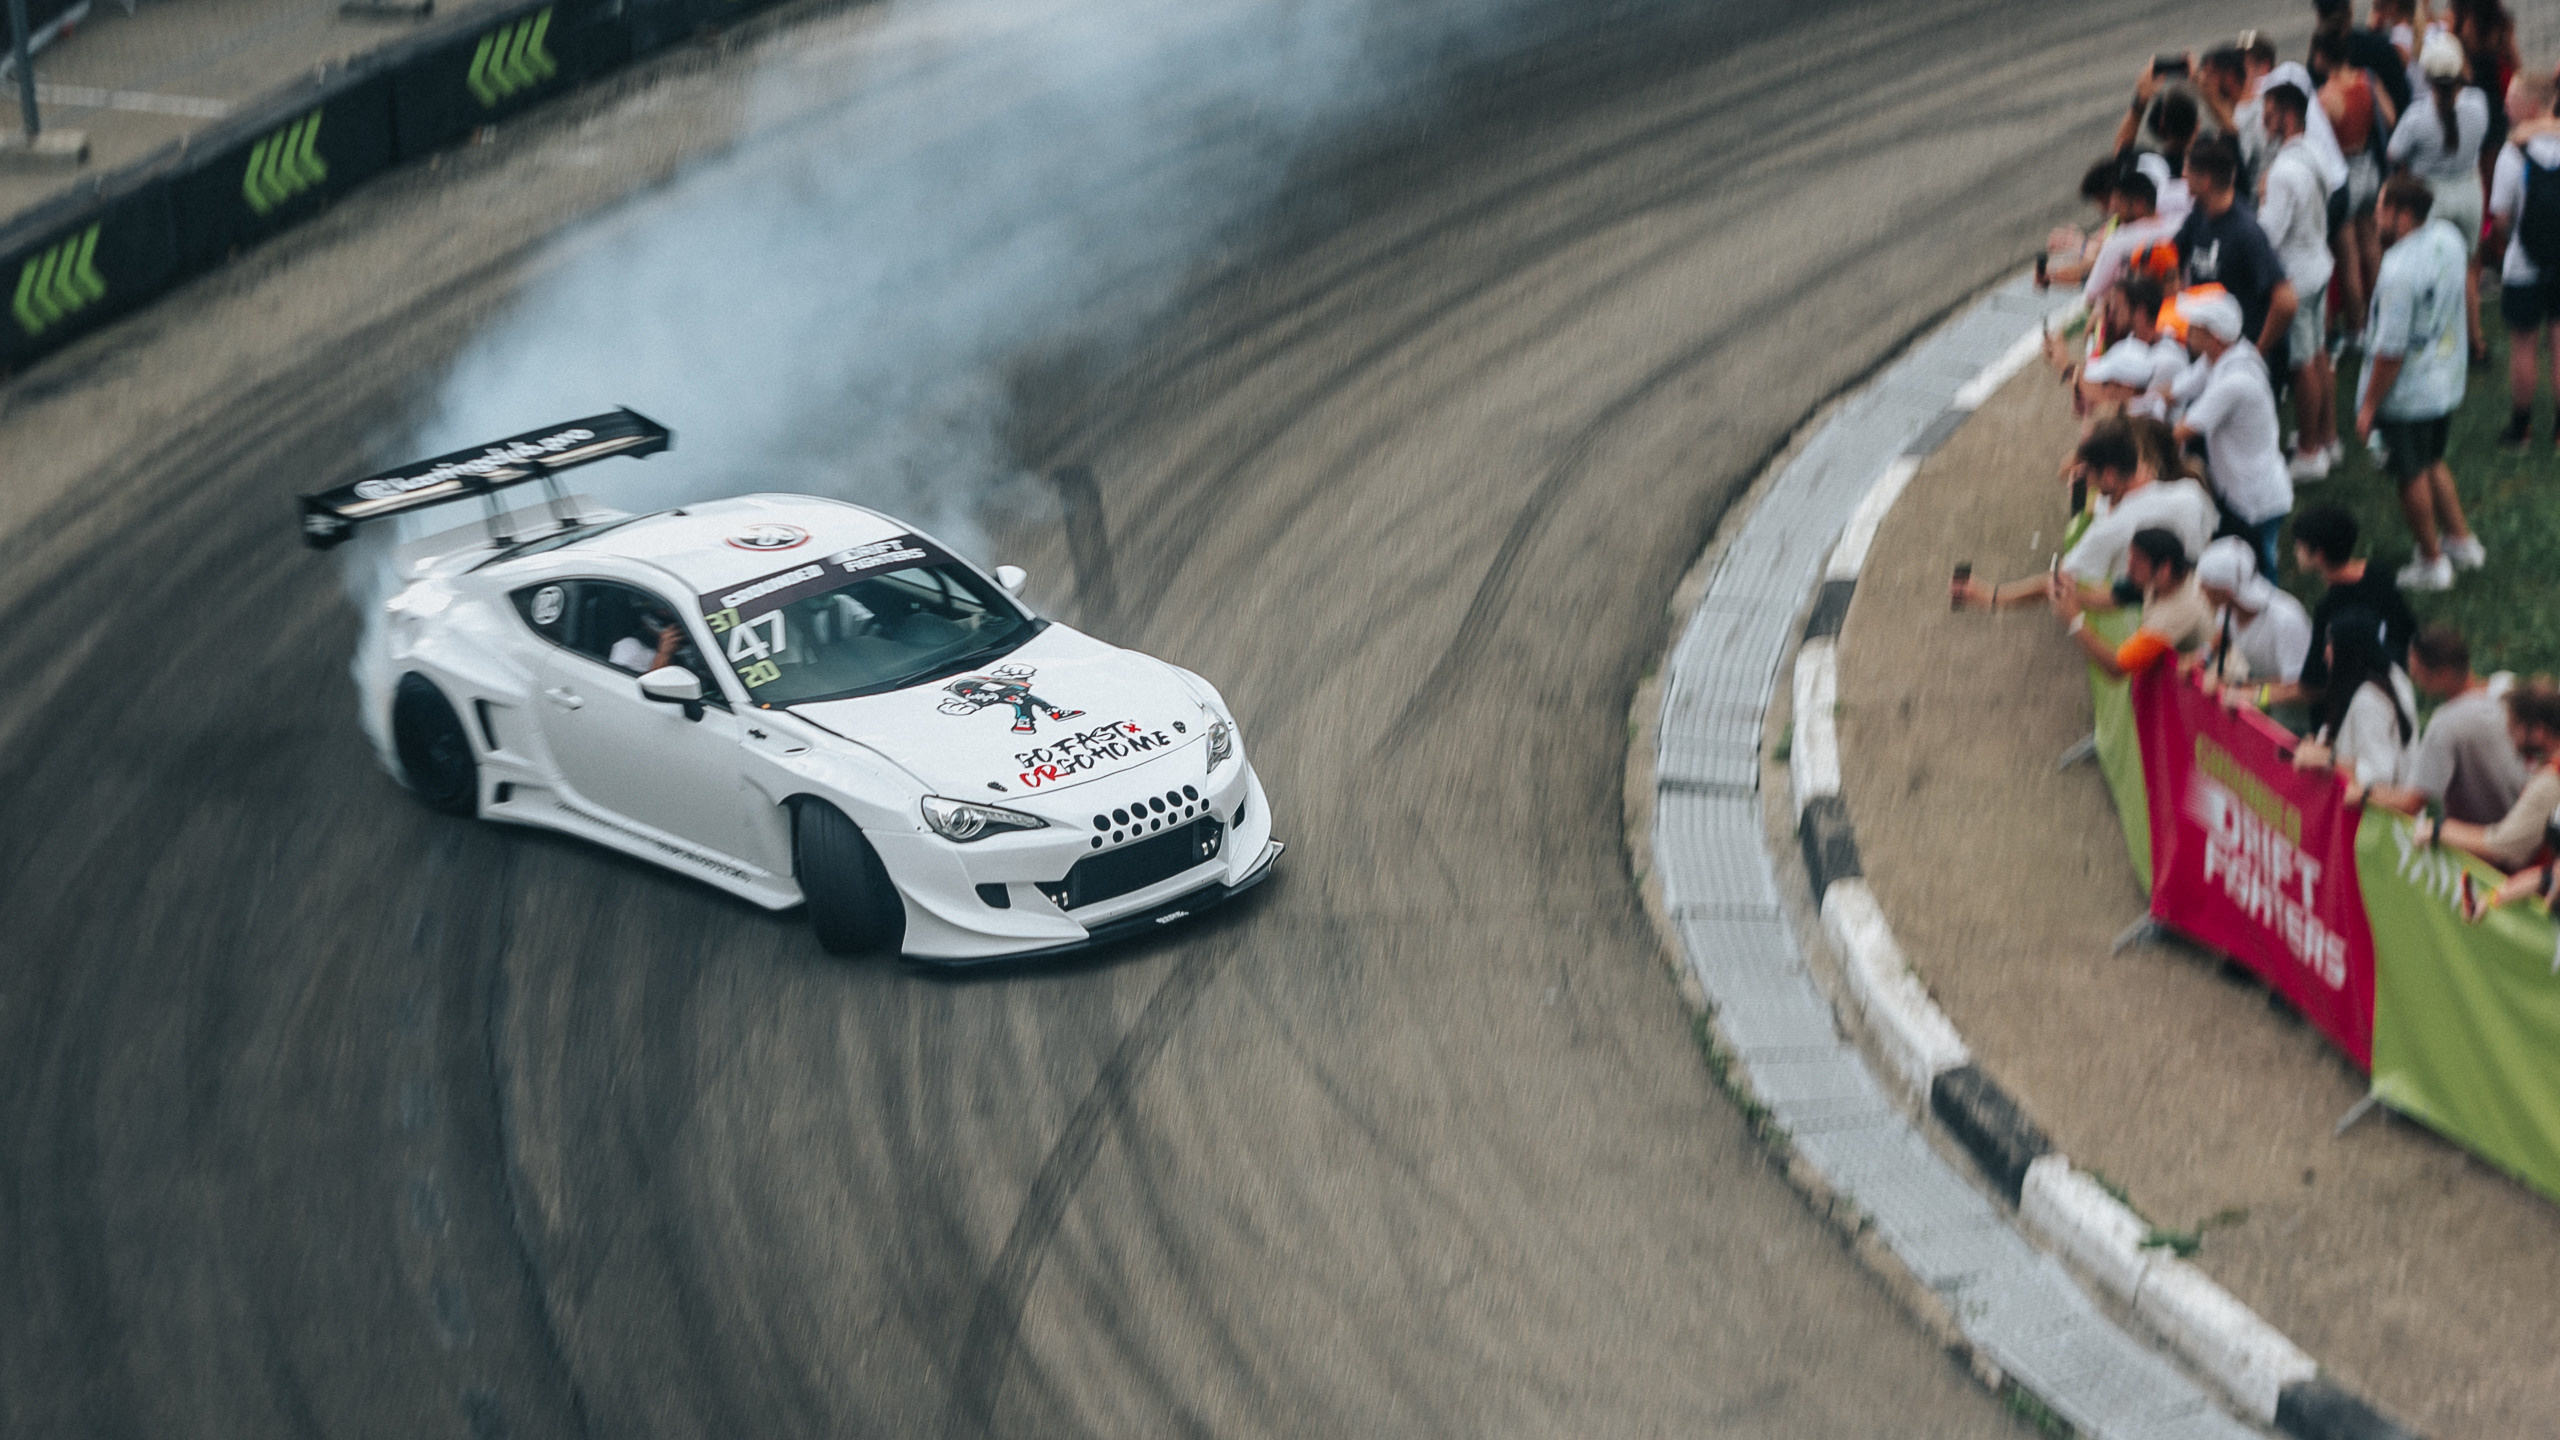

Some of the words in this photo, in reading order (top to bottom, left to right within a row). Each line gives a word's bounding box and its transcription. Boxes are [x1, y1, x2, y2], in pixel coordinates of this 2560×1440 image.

[842, 548, 927, 573] FIGHTERS
[846, 540, 906, 561] DRIFT
[705, 608, 741, 634] 37
[727, 609, 787, 663] 47
[737, 661, 782, 689] 20
[1015, 748, 1053, 769] GO
[1050, 720, 1127, 755] FAST
[1020, 765, 1072, 788] OR
[2204, 782, 2322, 909] DRIFT
[2203, 832, 2347, 991] FIGHTERS
